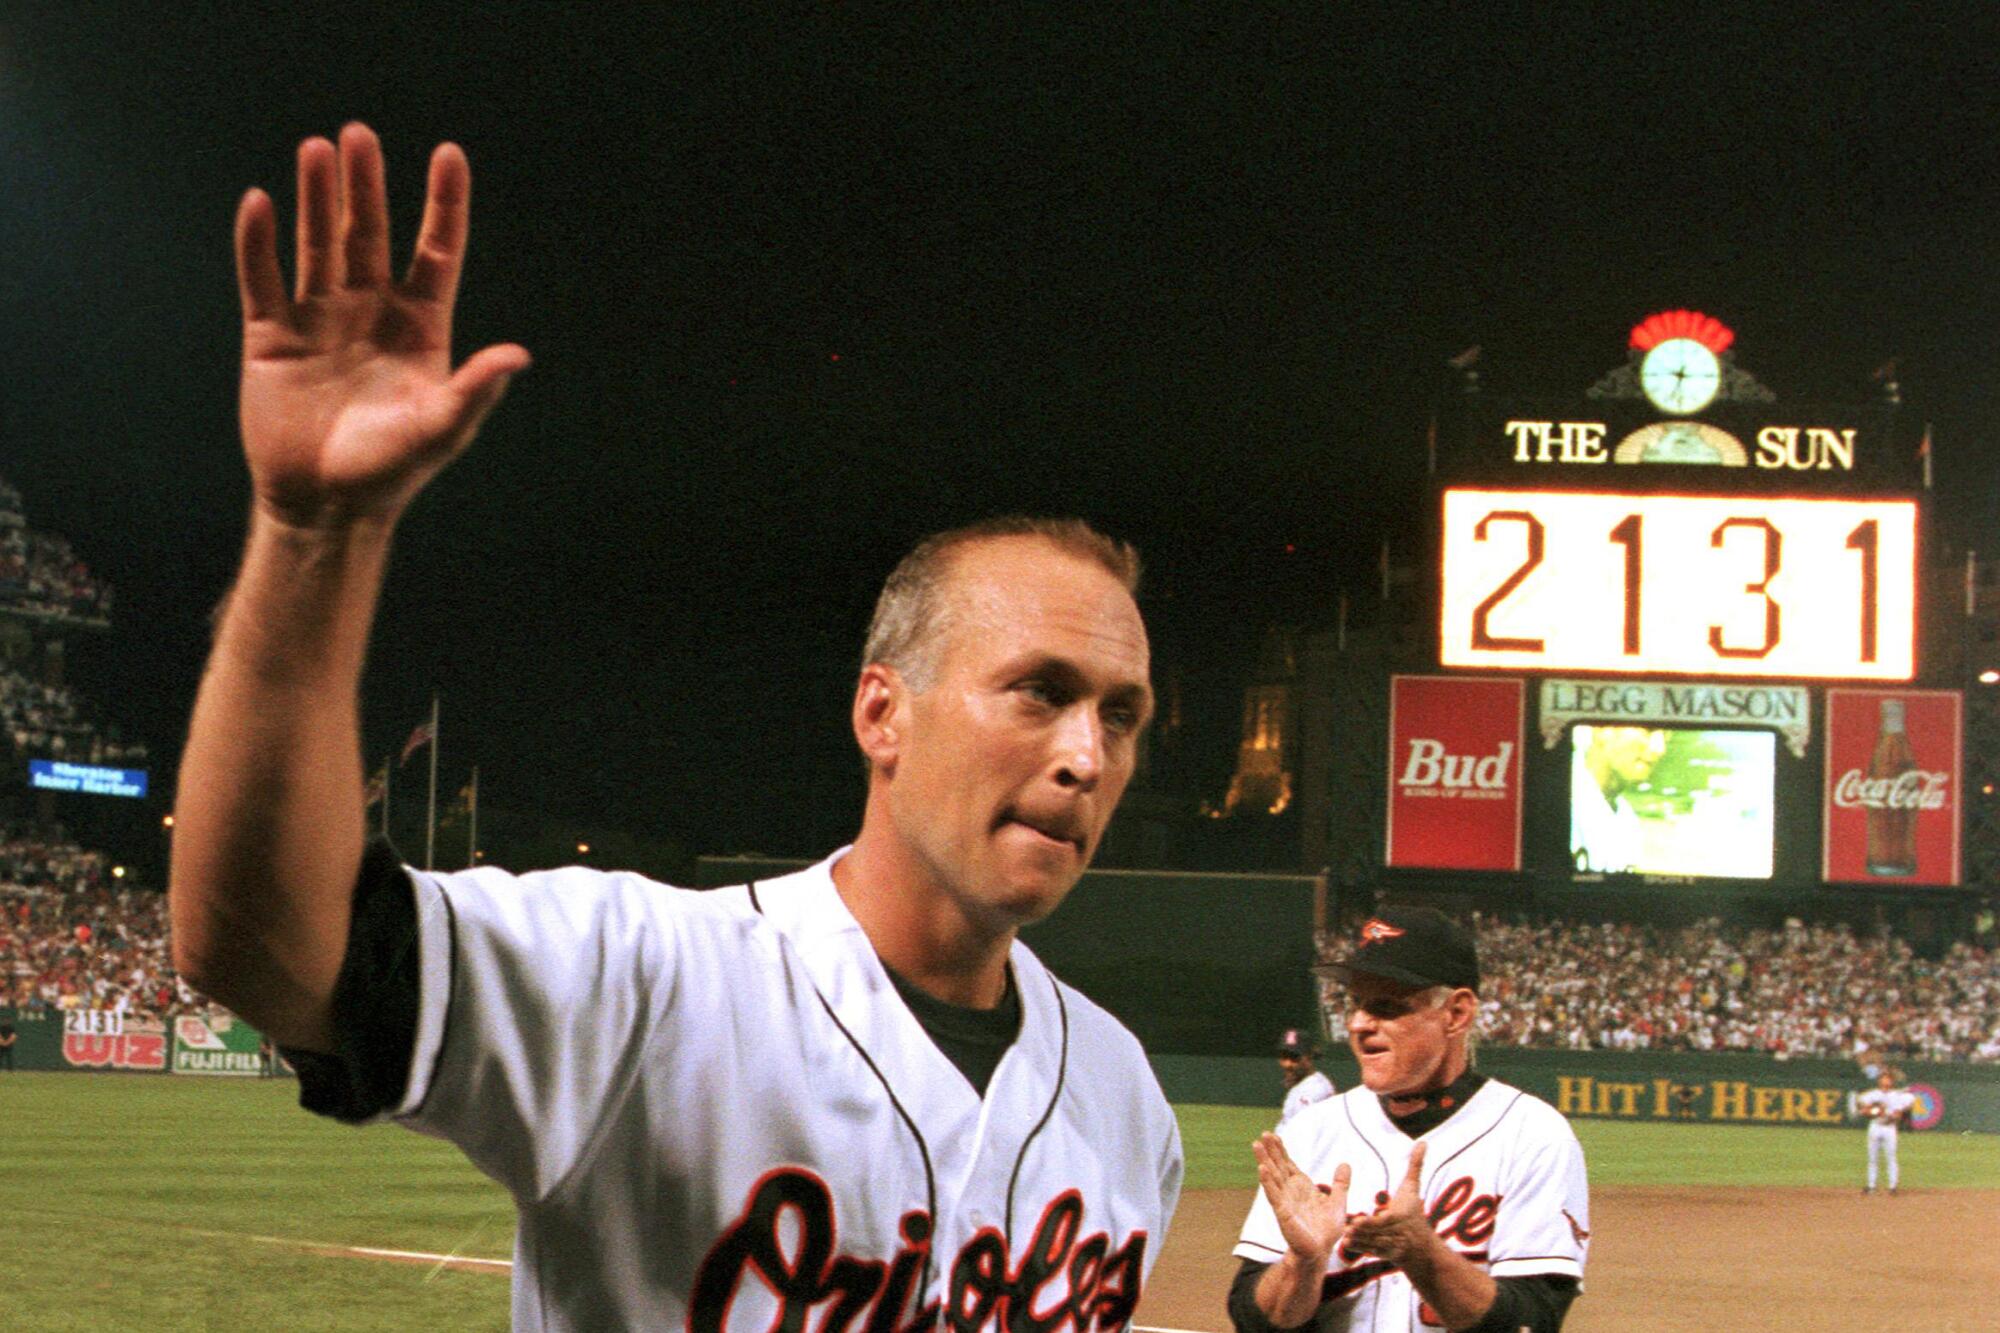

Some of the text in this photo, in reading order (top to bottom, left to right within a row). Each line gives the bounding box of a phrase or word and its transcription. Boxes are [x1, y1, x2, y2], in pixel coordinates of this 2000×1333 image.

[1505, 421, 1857, 471] THE SUN
[1551, 682, 1797, 720] LEGG MASON
[1398, 738, 1514, 789] Bud
[1556, 1075, 1646, 1116] HIT
[1711, 1080, 1843, 1123] HERE
[686, 1166, 1147, 1333] Orioles
